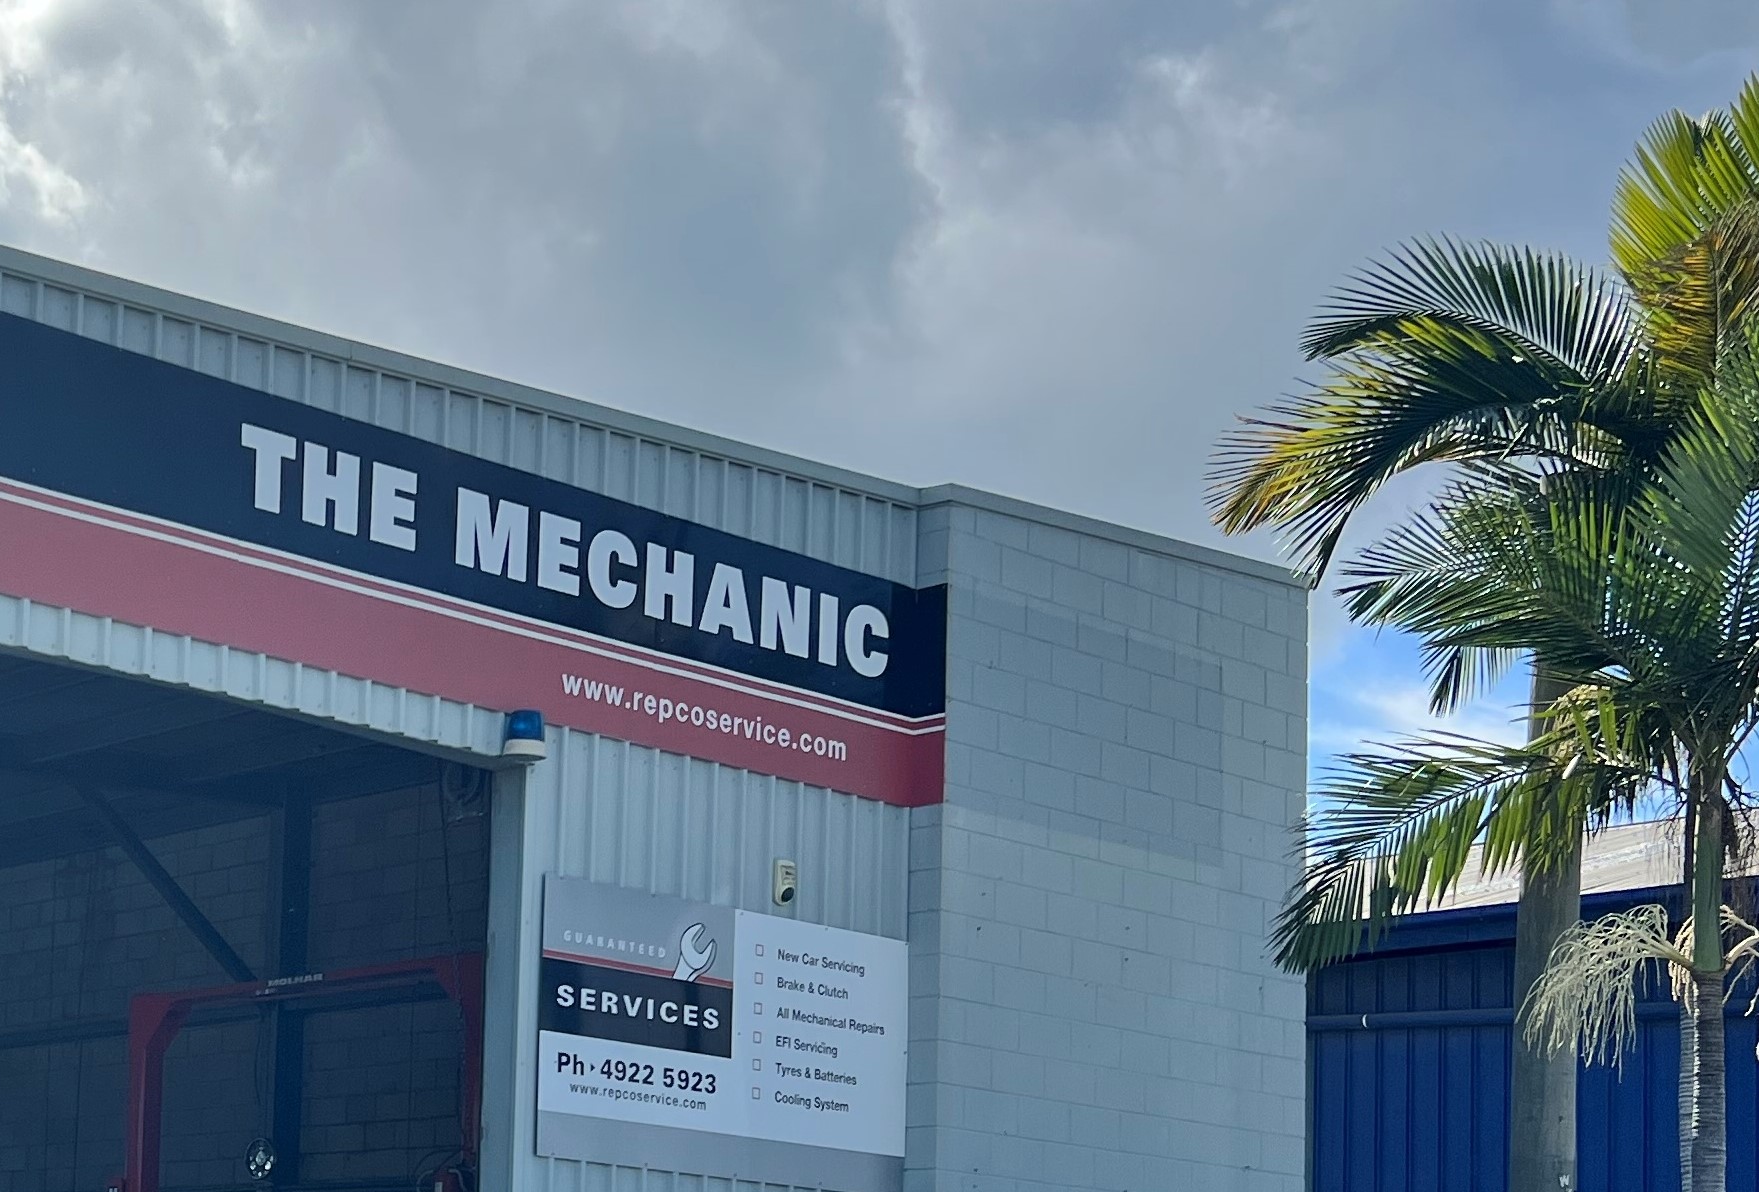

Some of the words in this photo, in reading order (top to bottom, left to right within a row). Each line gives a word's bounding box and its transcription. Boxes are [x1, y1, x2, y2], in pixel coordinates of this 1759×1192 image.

[240, 421, 419, 552] THE
[454, 484, 891, 679] MECHANIC
[560, 672, 848, 763] www.repcoservice.com
[563, 929, 667, 959] GUARANTEED
[777, 948, 798, 963] New
[800, 952, 820, 966] Car
[821, 955, 866, 978] Servicing
[777, 976, 806, 994] Brake
[807, 982, 816, 994] &
[818, 981, 849, 1000] Clutch
[555, 983, 720, 1030] SERVICES
[776, 1006, 790, 1020] All
[792, 1008, 847, 1030] Mechanical
[849, 1017, 886, 1036] Repairs
[775, 1035, 792, 1049] EFI
[794, 1037, 839, 1058] Servicing
[556, 1051, 586, 1076] Ph
[599, 1057, 655, 1086] 4922
[662, 1067, 717, 1094] 5923
[775, 1062, 802, 1079] Tyres
[804, 1068, 813, 1079] &
[814, 1067, 858, 1087] Batteries
[569, 1081, 707, 1111] www.repcoservice.com
[774, 1090, 812, 1110] Cooling
[814, 1094, 850, 1113] System
